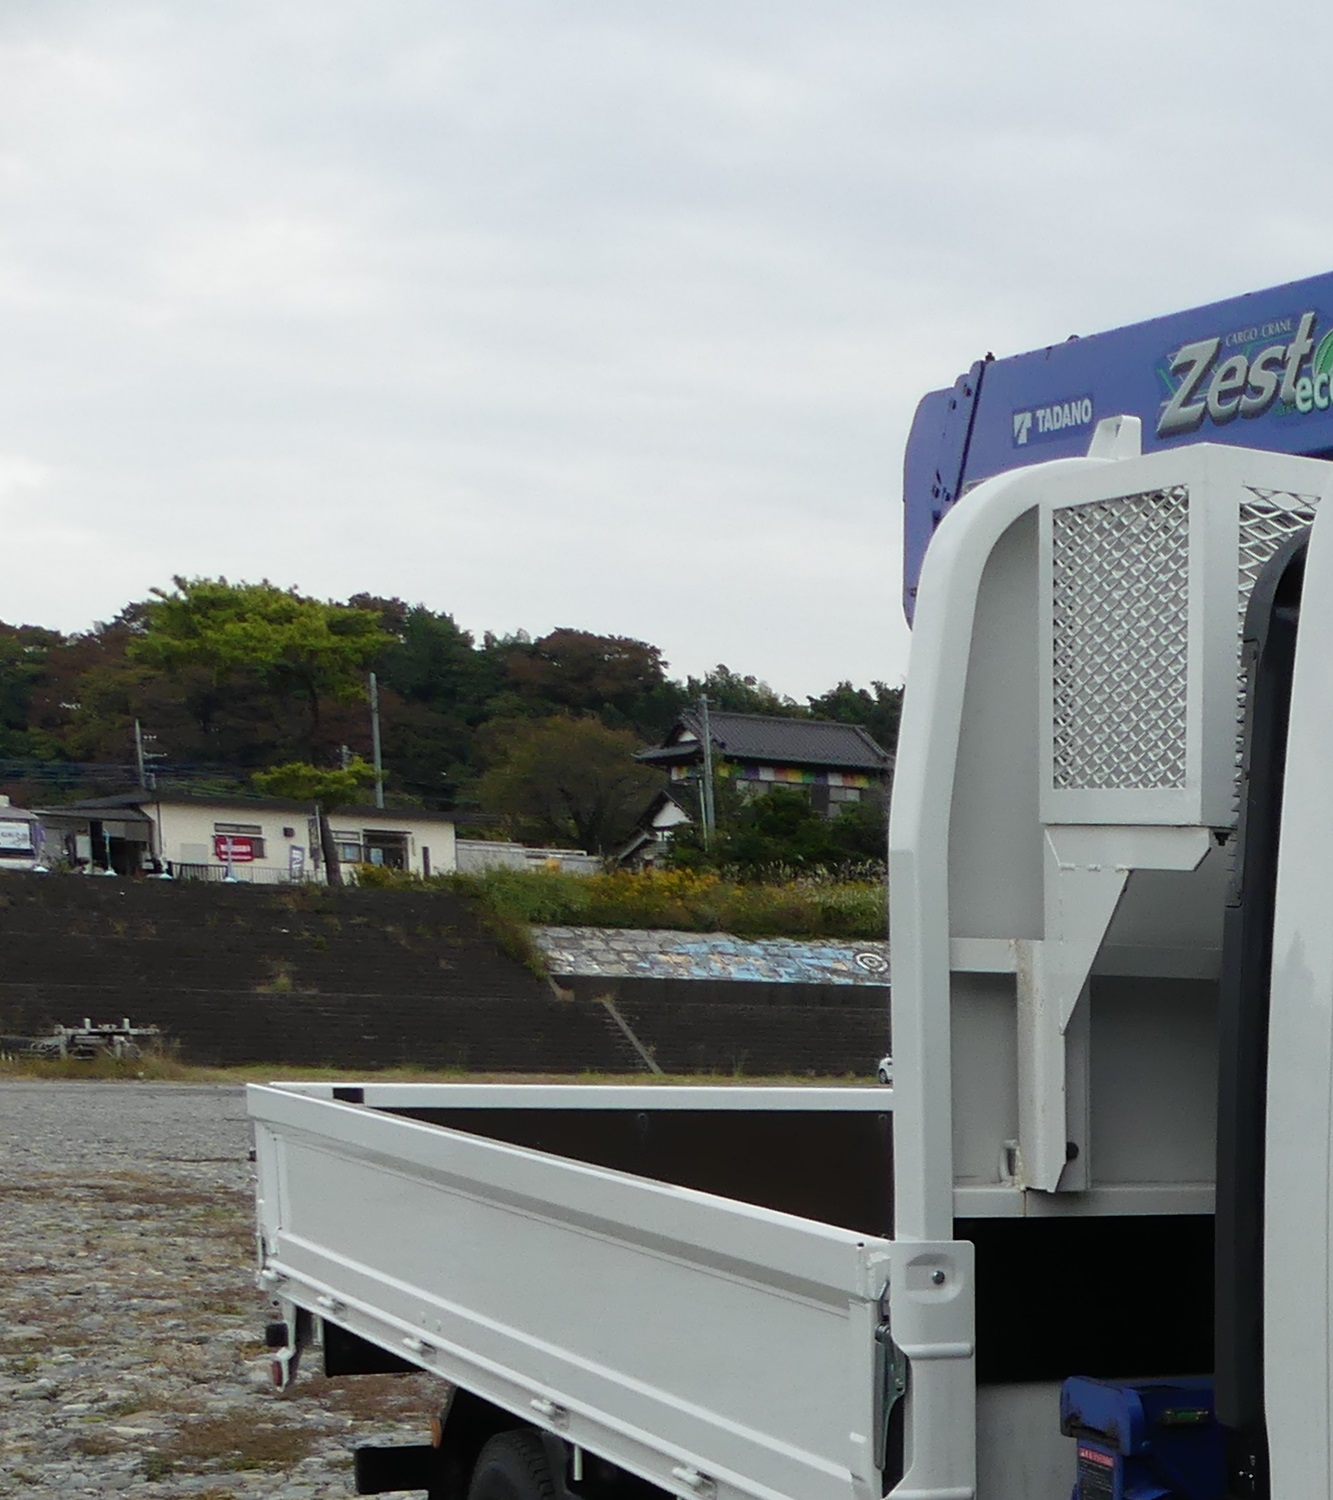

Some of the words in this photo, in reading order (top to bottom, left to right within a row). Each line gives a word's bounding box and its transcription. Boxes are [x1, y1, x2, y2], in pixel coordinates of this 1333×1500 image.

[1225, 329, 1258, 347] CARGO
[1261, 319, 1293, 337] CRANE
[1156, 311, 1316, 438] Zest
[1036, 398, 1092, 433] TADANO
